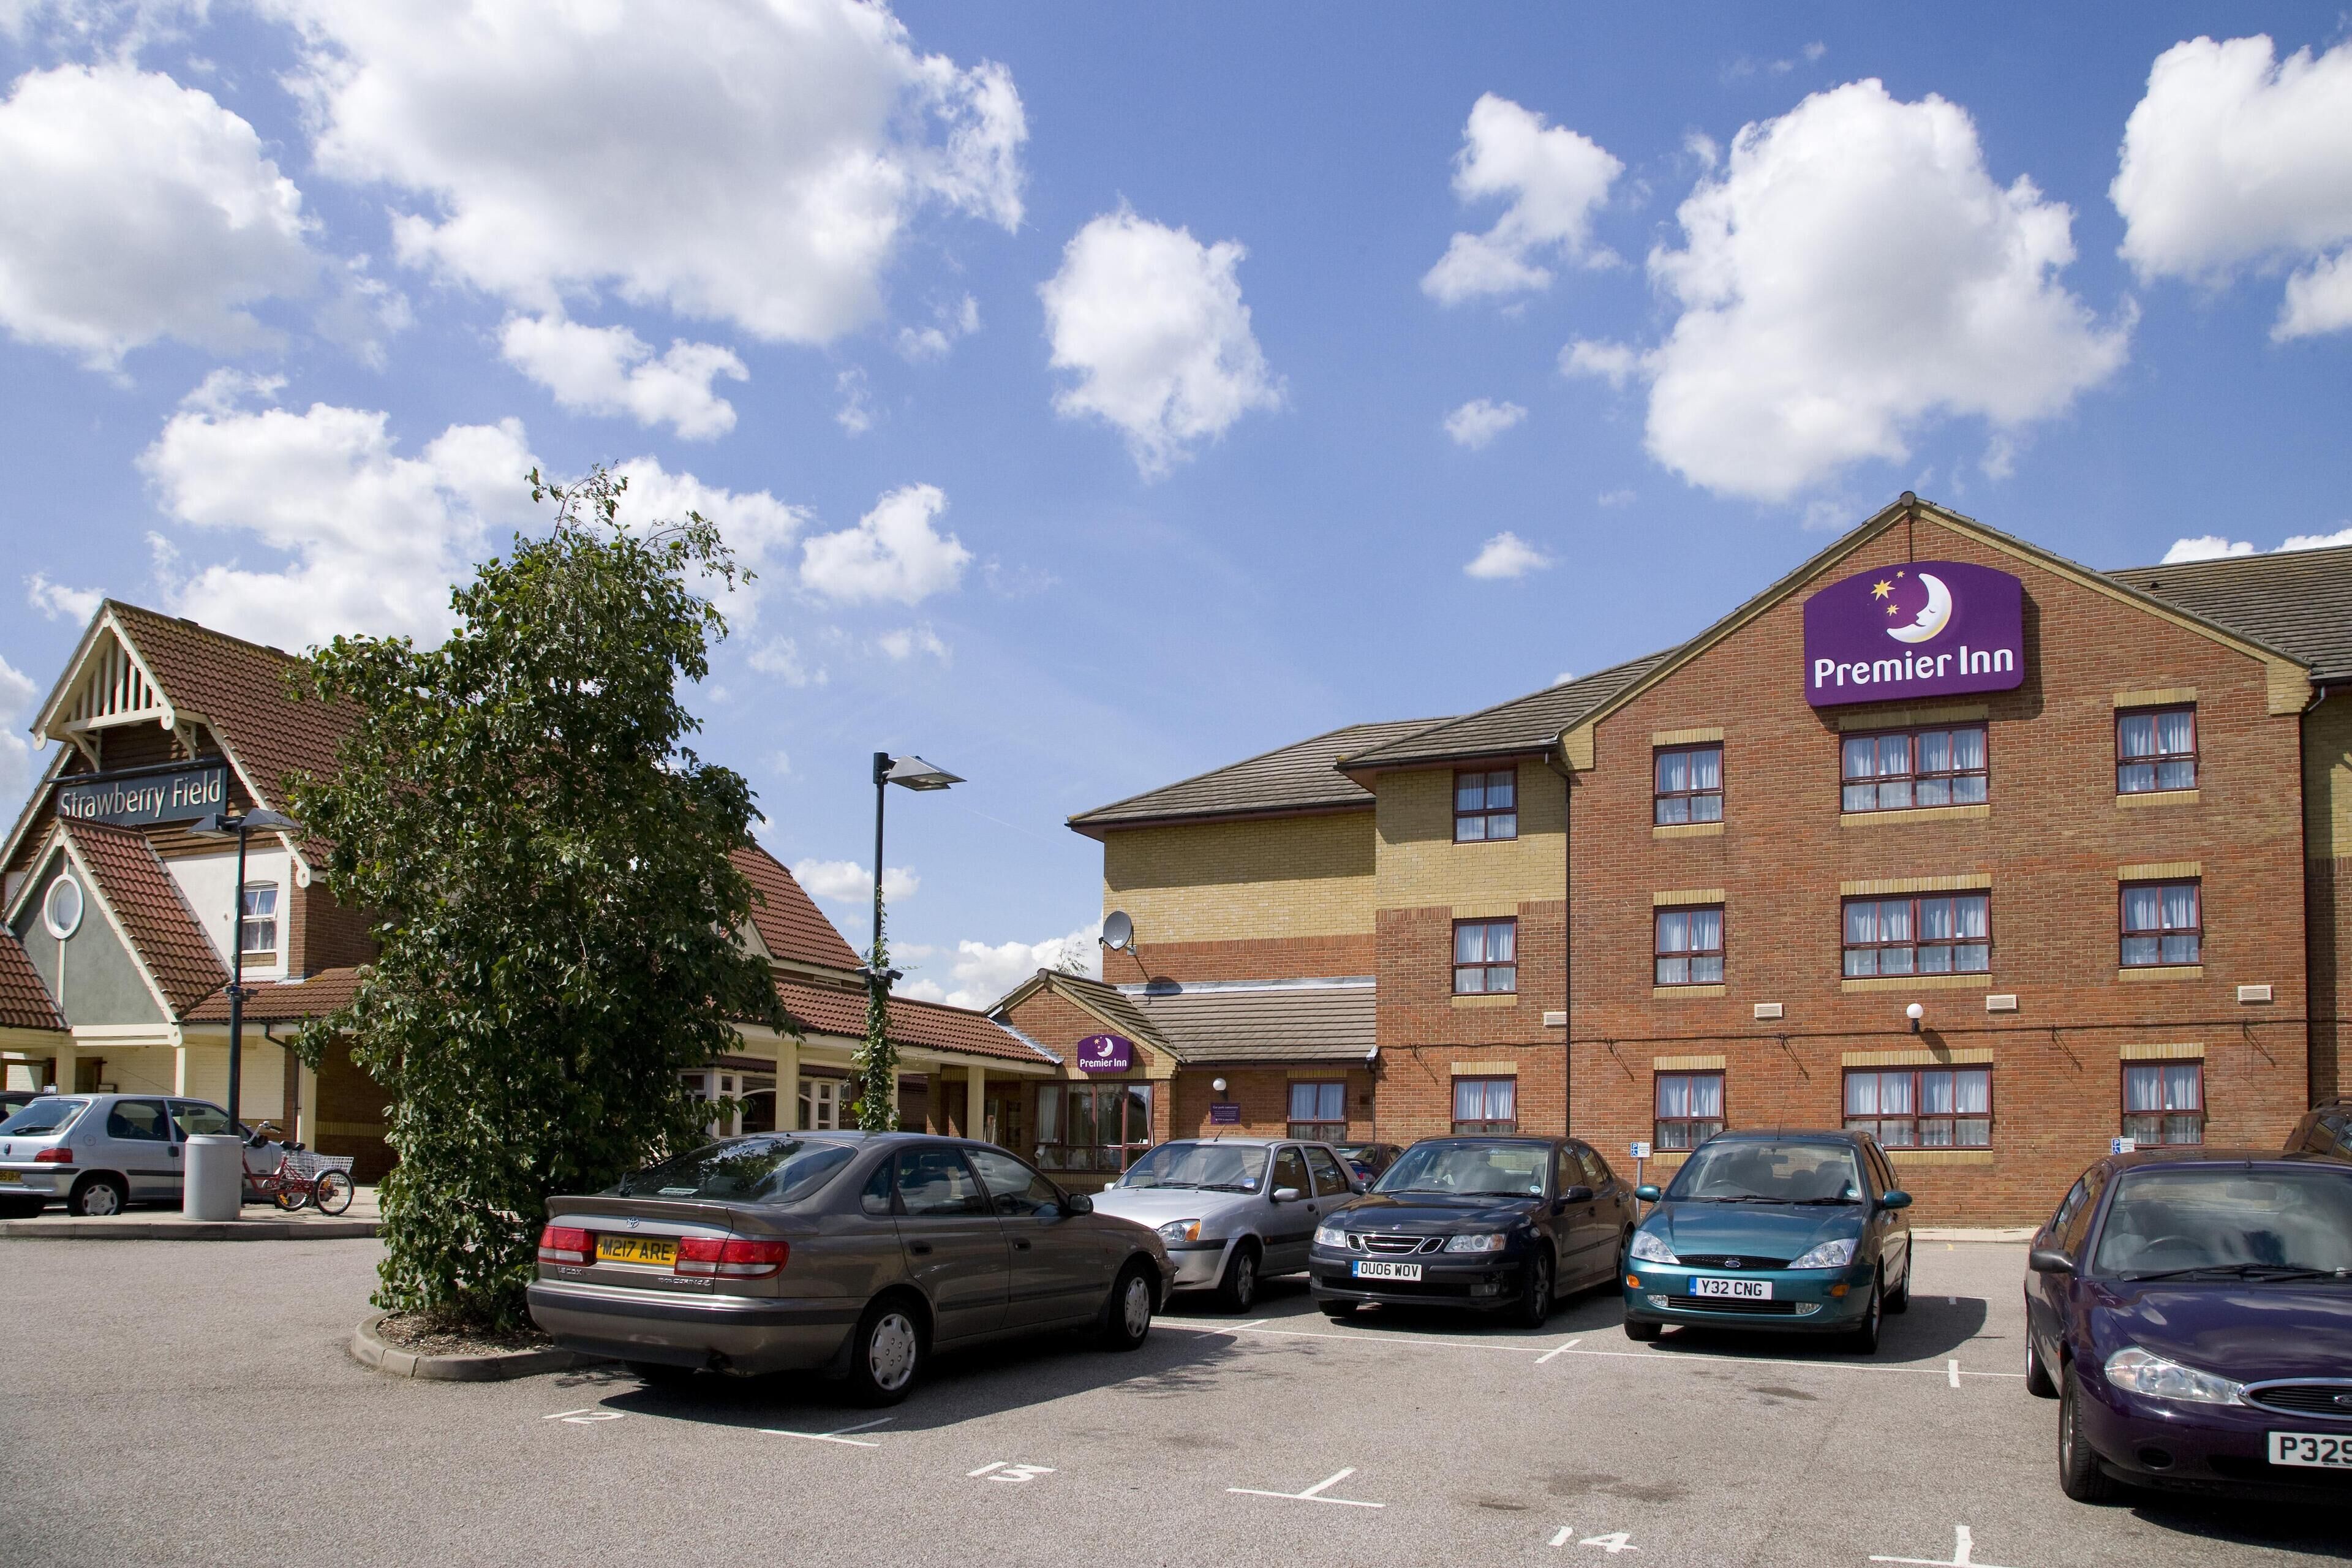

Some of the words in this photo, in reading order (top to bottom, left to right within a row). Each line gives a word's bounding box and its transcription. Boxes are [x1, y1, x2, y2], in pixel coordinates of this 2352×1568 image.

[1814, 650, 1953, 688] Premier
[1959, 645, 2014, 675] Inn
[61, 783, 167, 818] Strawberry
[173, 769, 222, 807] Field
[1080, 1058, 1113, 1068] Premier
[1114, 1058, 1127, 1067] Inn
[602, 1238, 636, 1258] M217
[639, 1242, 673, 1261] ARE
[1361, 1262, 1391, 1275] OU06
[1395, 1264, 1419, 1277] WOV
[1702, 1280, 1729, 1294] Y32
[1734, 1281, 1762, 1296] CNG
[541, 1408, 625, 1424] 12
[965, 1461, 1059, 1482] 13
[1548, 1526, 1638, 1553] 14
